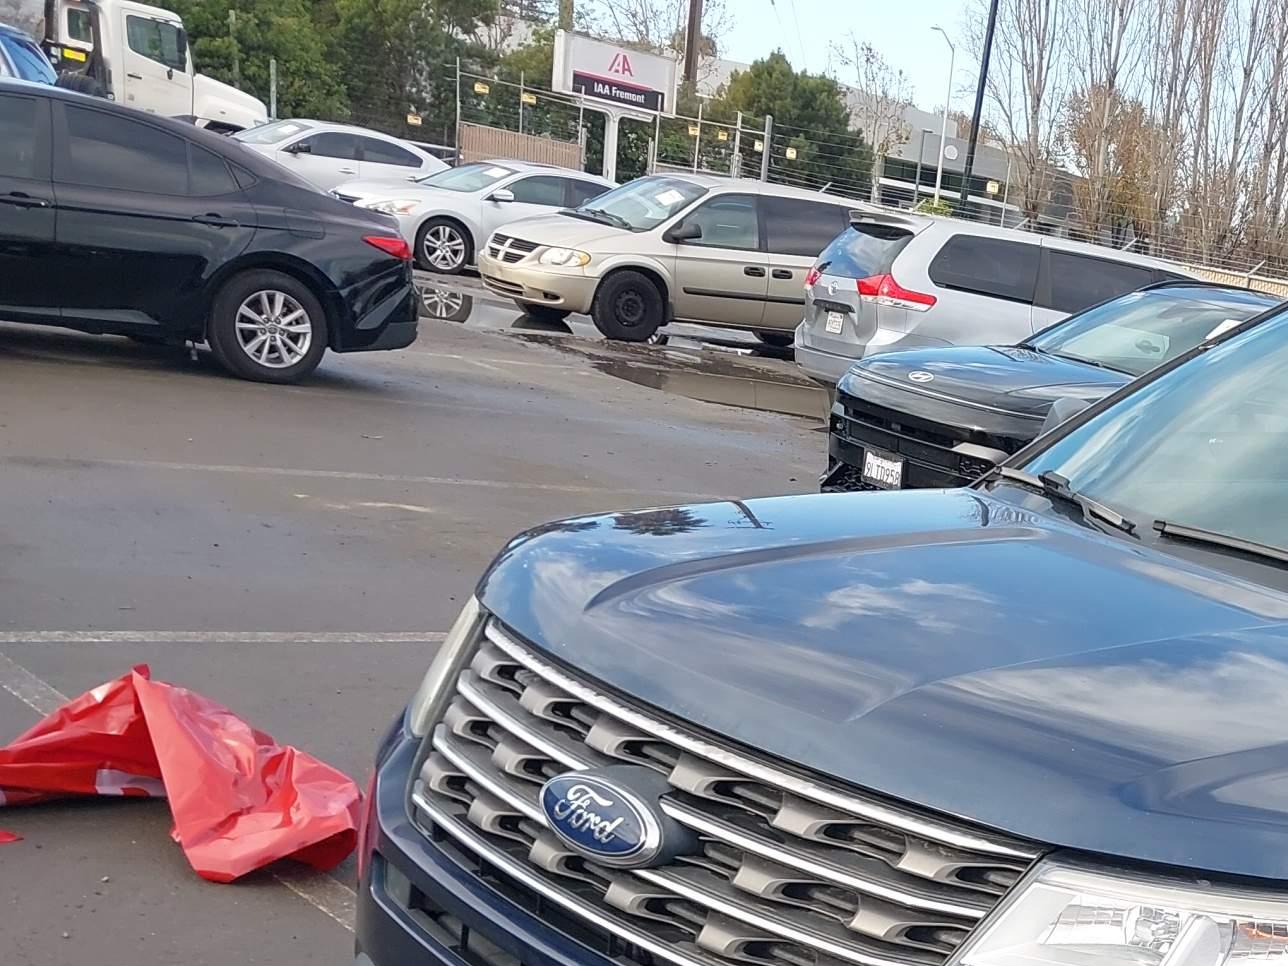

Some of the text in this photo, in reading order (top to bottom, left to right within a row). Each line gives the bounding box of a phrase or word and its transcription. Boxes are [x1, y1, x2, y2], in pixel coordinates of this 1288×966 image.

[593, 82, 645, 104] IAA Fremont
[555, 784, 623, 844] Ford
